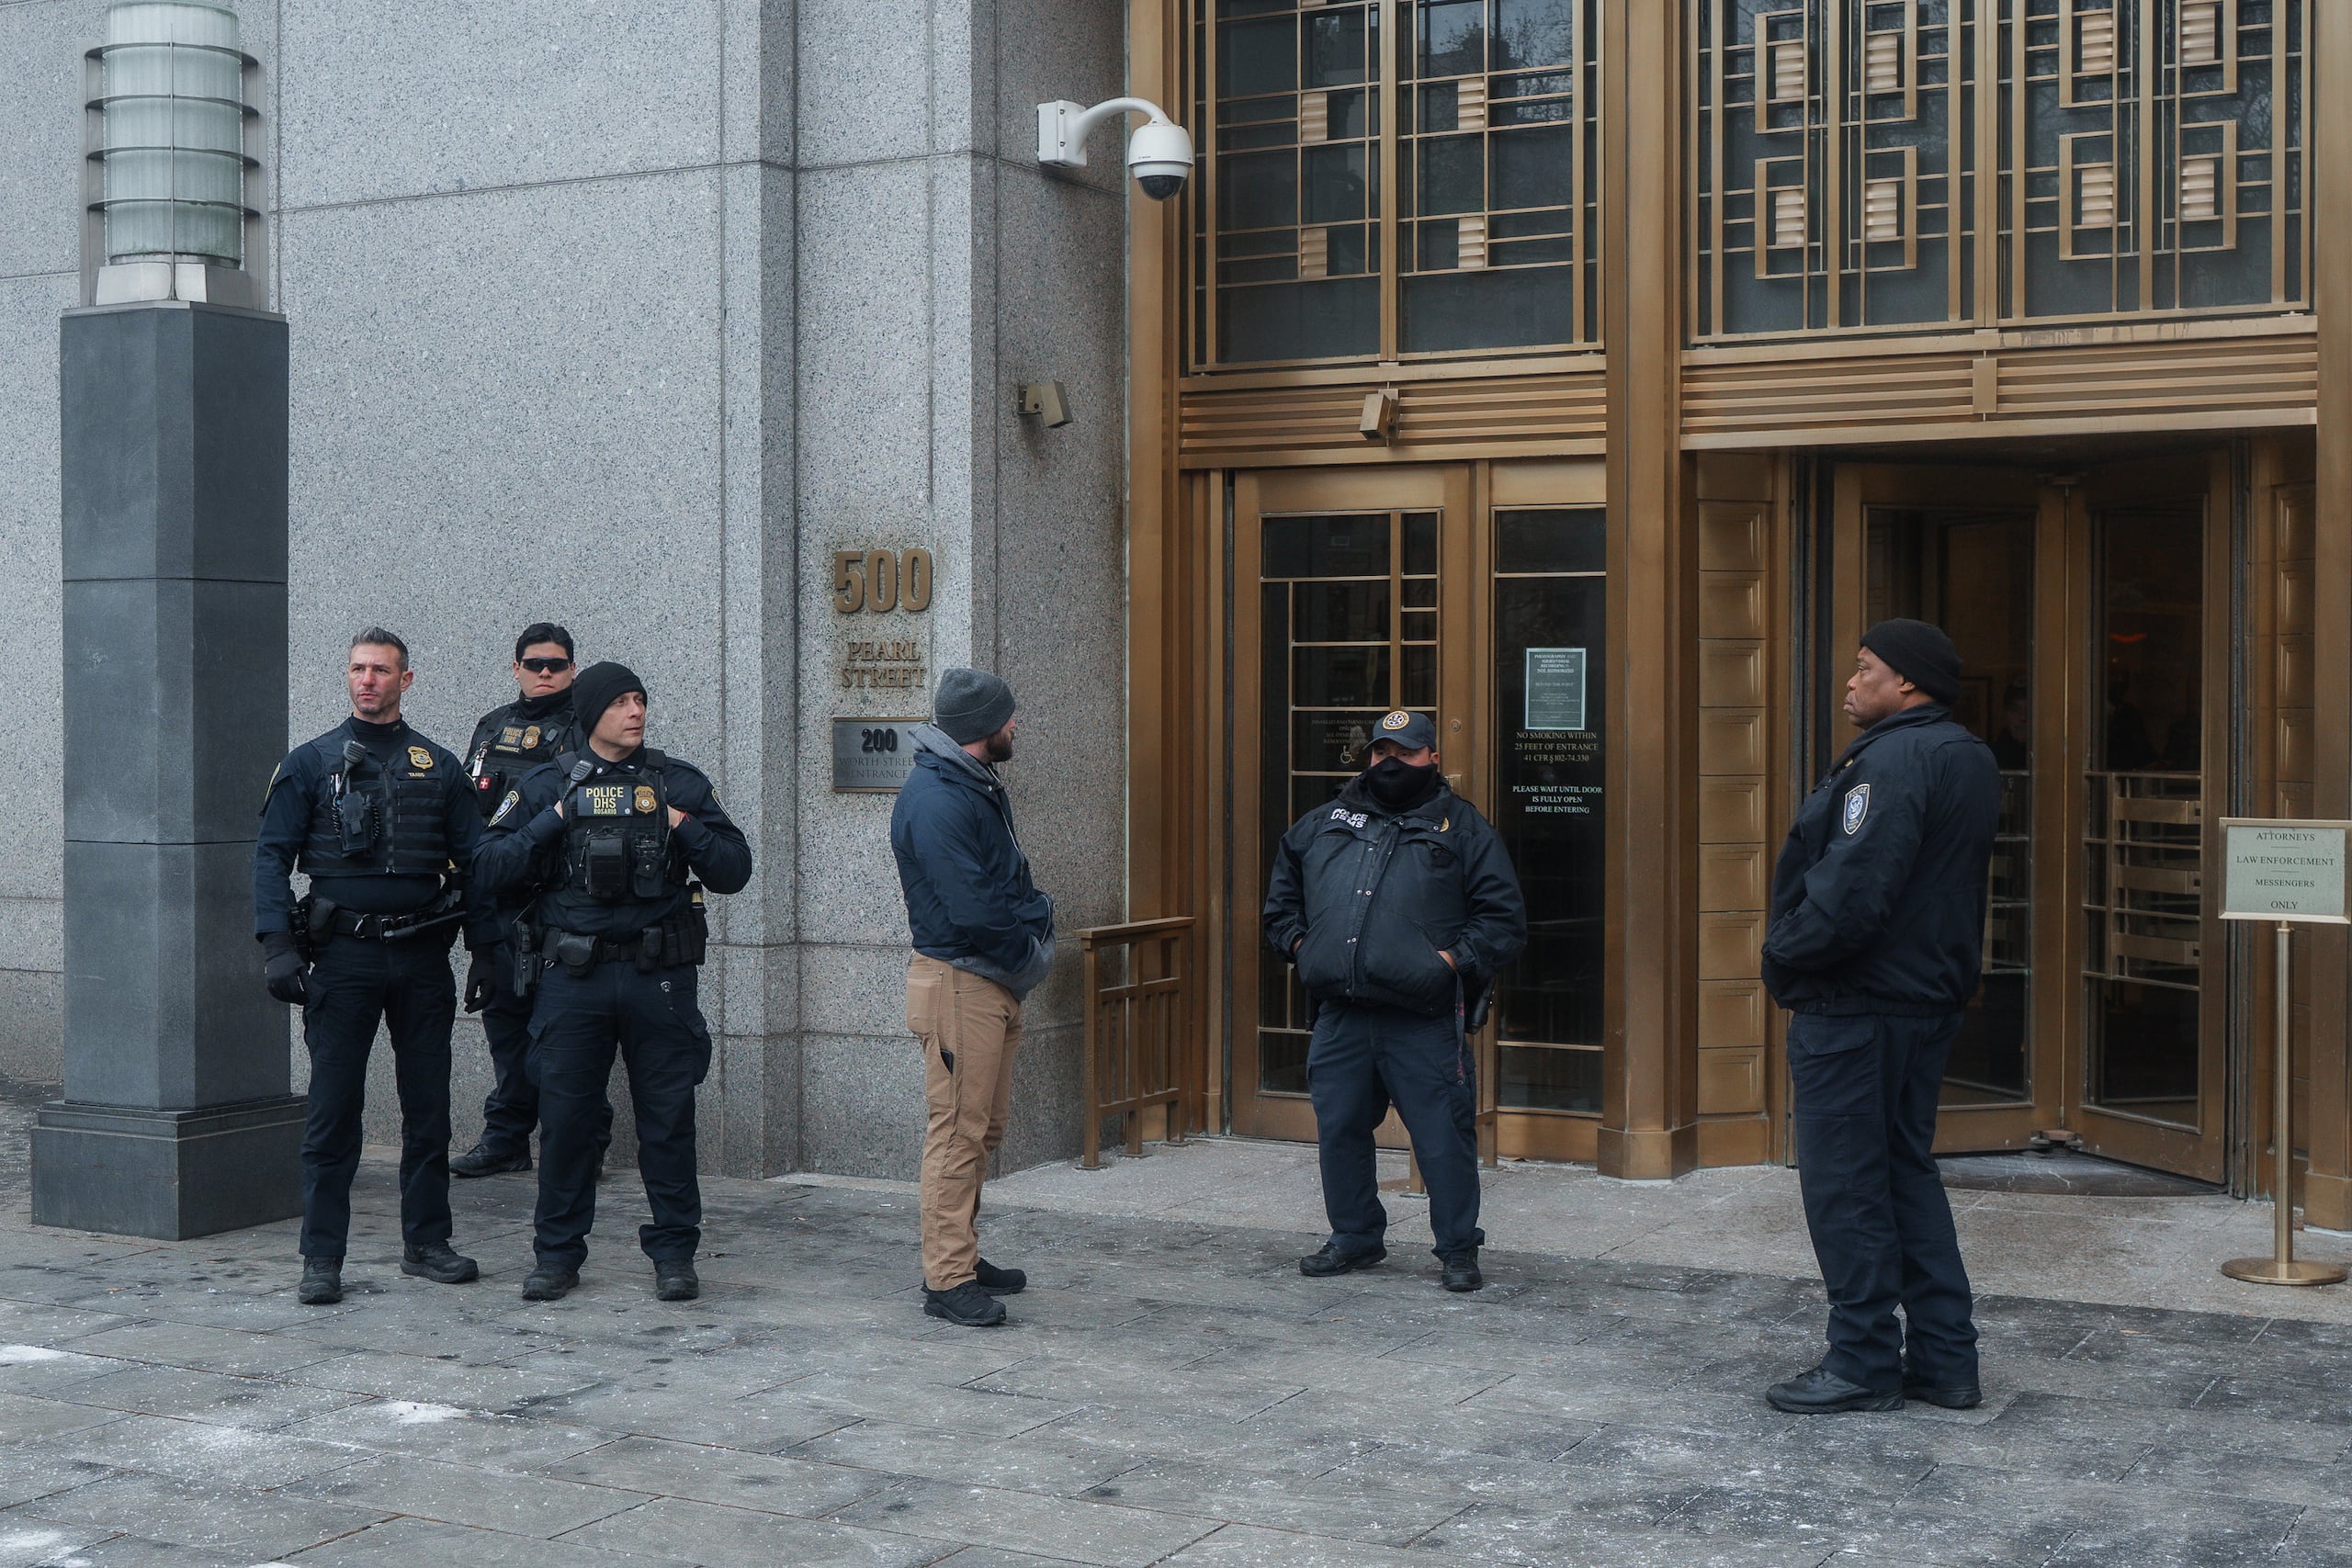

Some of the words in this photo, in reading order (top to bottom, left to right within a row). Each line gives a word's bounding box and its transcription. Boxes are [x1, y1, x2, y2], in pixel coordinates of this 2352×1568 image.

[833, 547, 933, 614] 500
[847, 642, 921, 661] PEARL
[841, 668, 927, 688] STREET
[503, 727, 523, 738] POLICE
[1516, 731, 1528, 739] NO
[1529, 731, 1566, 739] SMOKING
[1566, 731, 1597, 739] WITHIN
[861, 728, 898, 752] 200
[1514, 742, 1522, 750] 25
[1524, 742, 1543, 750] FEET
[1544, 742, 1555, 750] OF
[1556, 742, 1599, 750] ENTRANCE
[839, 757, 879, 767] WORTH
[883, 757, 914, 767] STREE
[1523, 754, 1532, 762] 41
[850, 769, 909, 780] ENTRANCE
[585, 786, 625, 798] POLICE
[1512, 785, 1539, 794] PLEASE
[1539, 785, 1559, 794] WAIT
[1559, 785, 1581, 794] UNTIL
[1582, 786, 1603, 795] DOOR
[1848, 786, 1868, 800] POLICE
[594, 797, 616, 809] DHS
[1332, 807, 1369, 823] POLICE
[1525, 806, 1553, 814] BEFORE
[1554, 806, 1589, 815] ENTERING
[2256, 831, 2315, 842] ATTORNEYS
[2236, 855, 2258, 864] LAW
[2259, 856, 2335, 866] ENFORCEMENT
[2256, 878, 2315, 888] MESSENGERS
[2270, 900, 2299, 909] ONLY
